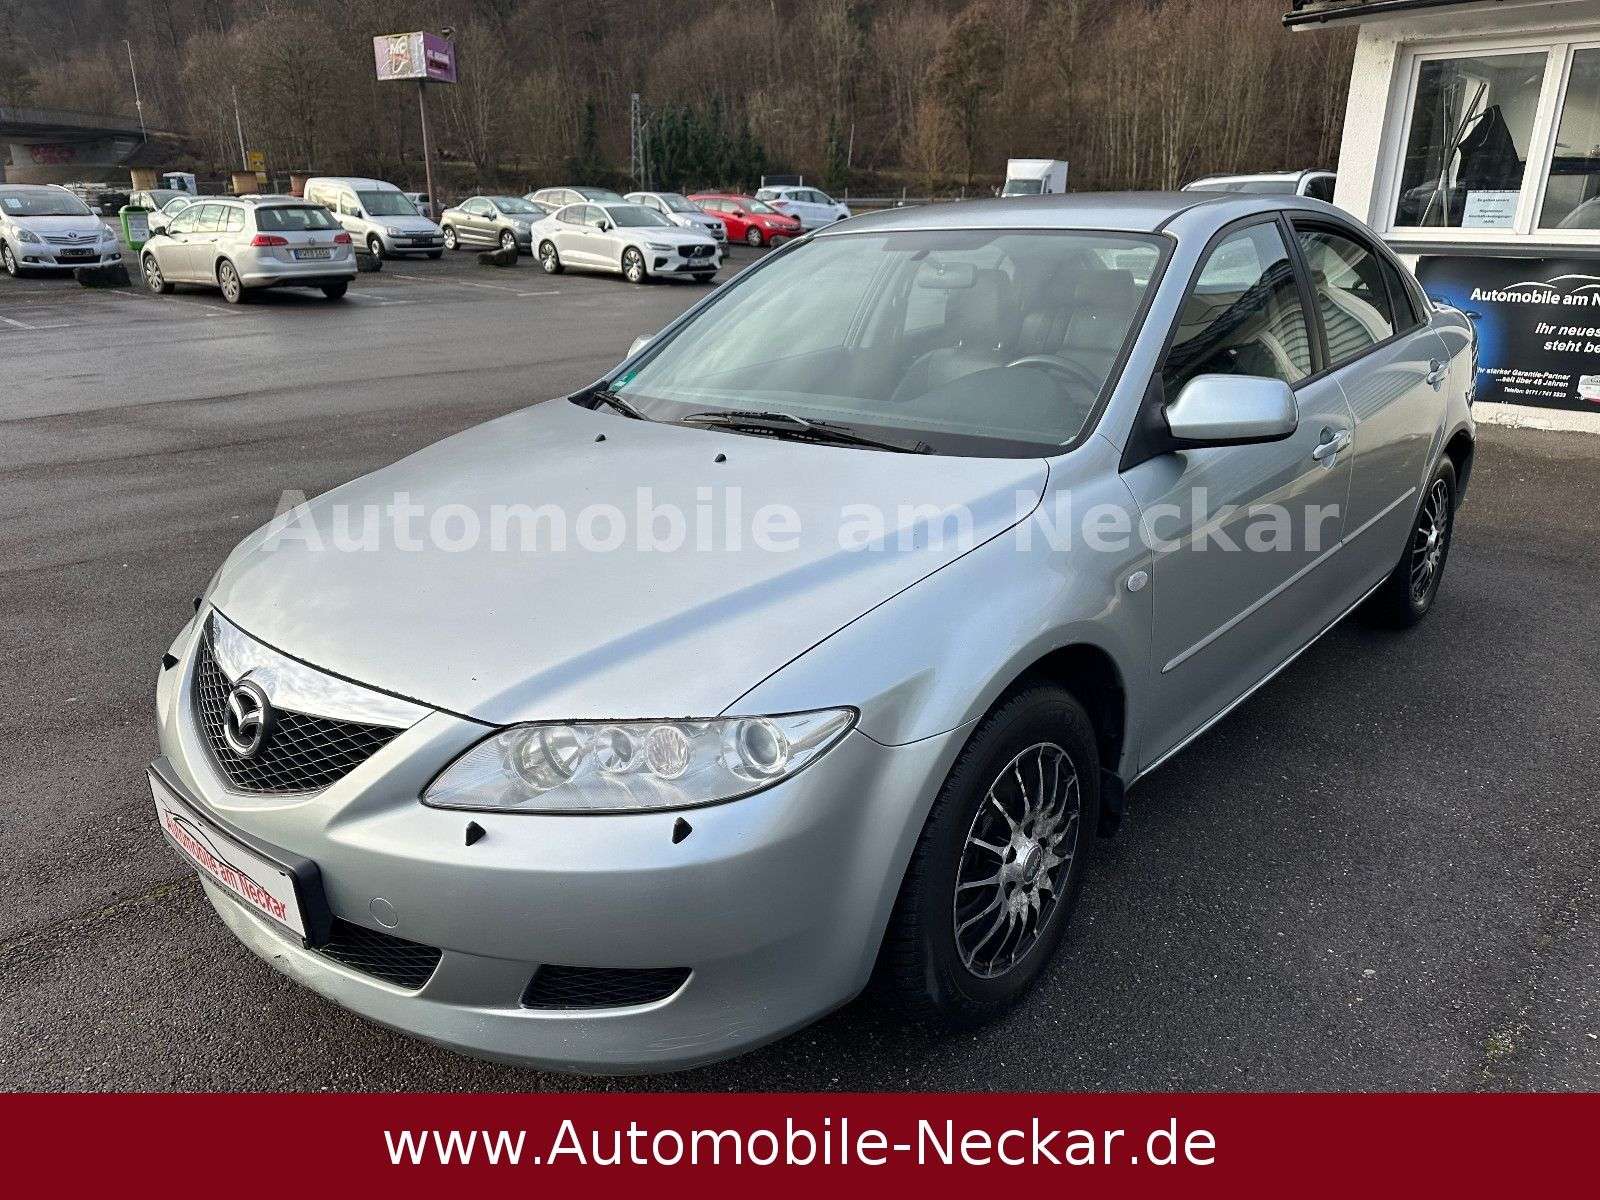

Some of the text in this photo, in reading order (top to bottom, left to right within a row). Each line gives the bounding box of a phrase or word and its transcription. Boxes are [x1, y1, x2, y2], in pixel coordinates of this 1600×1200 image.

[1470, 287, 1561, 306] Automobile
[1563, 294, 1589, 306] am
[1535, 322, 1600, 337] Ihr neues
[1543, 340, 1581, 353] steht
[166, 812, 219, 876] Automobile
[219, 862, 240, 891] am
[240, 873, 287, 921] Neckar
